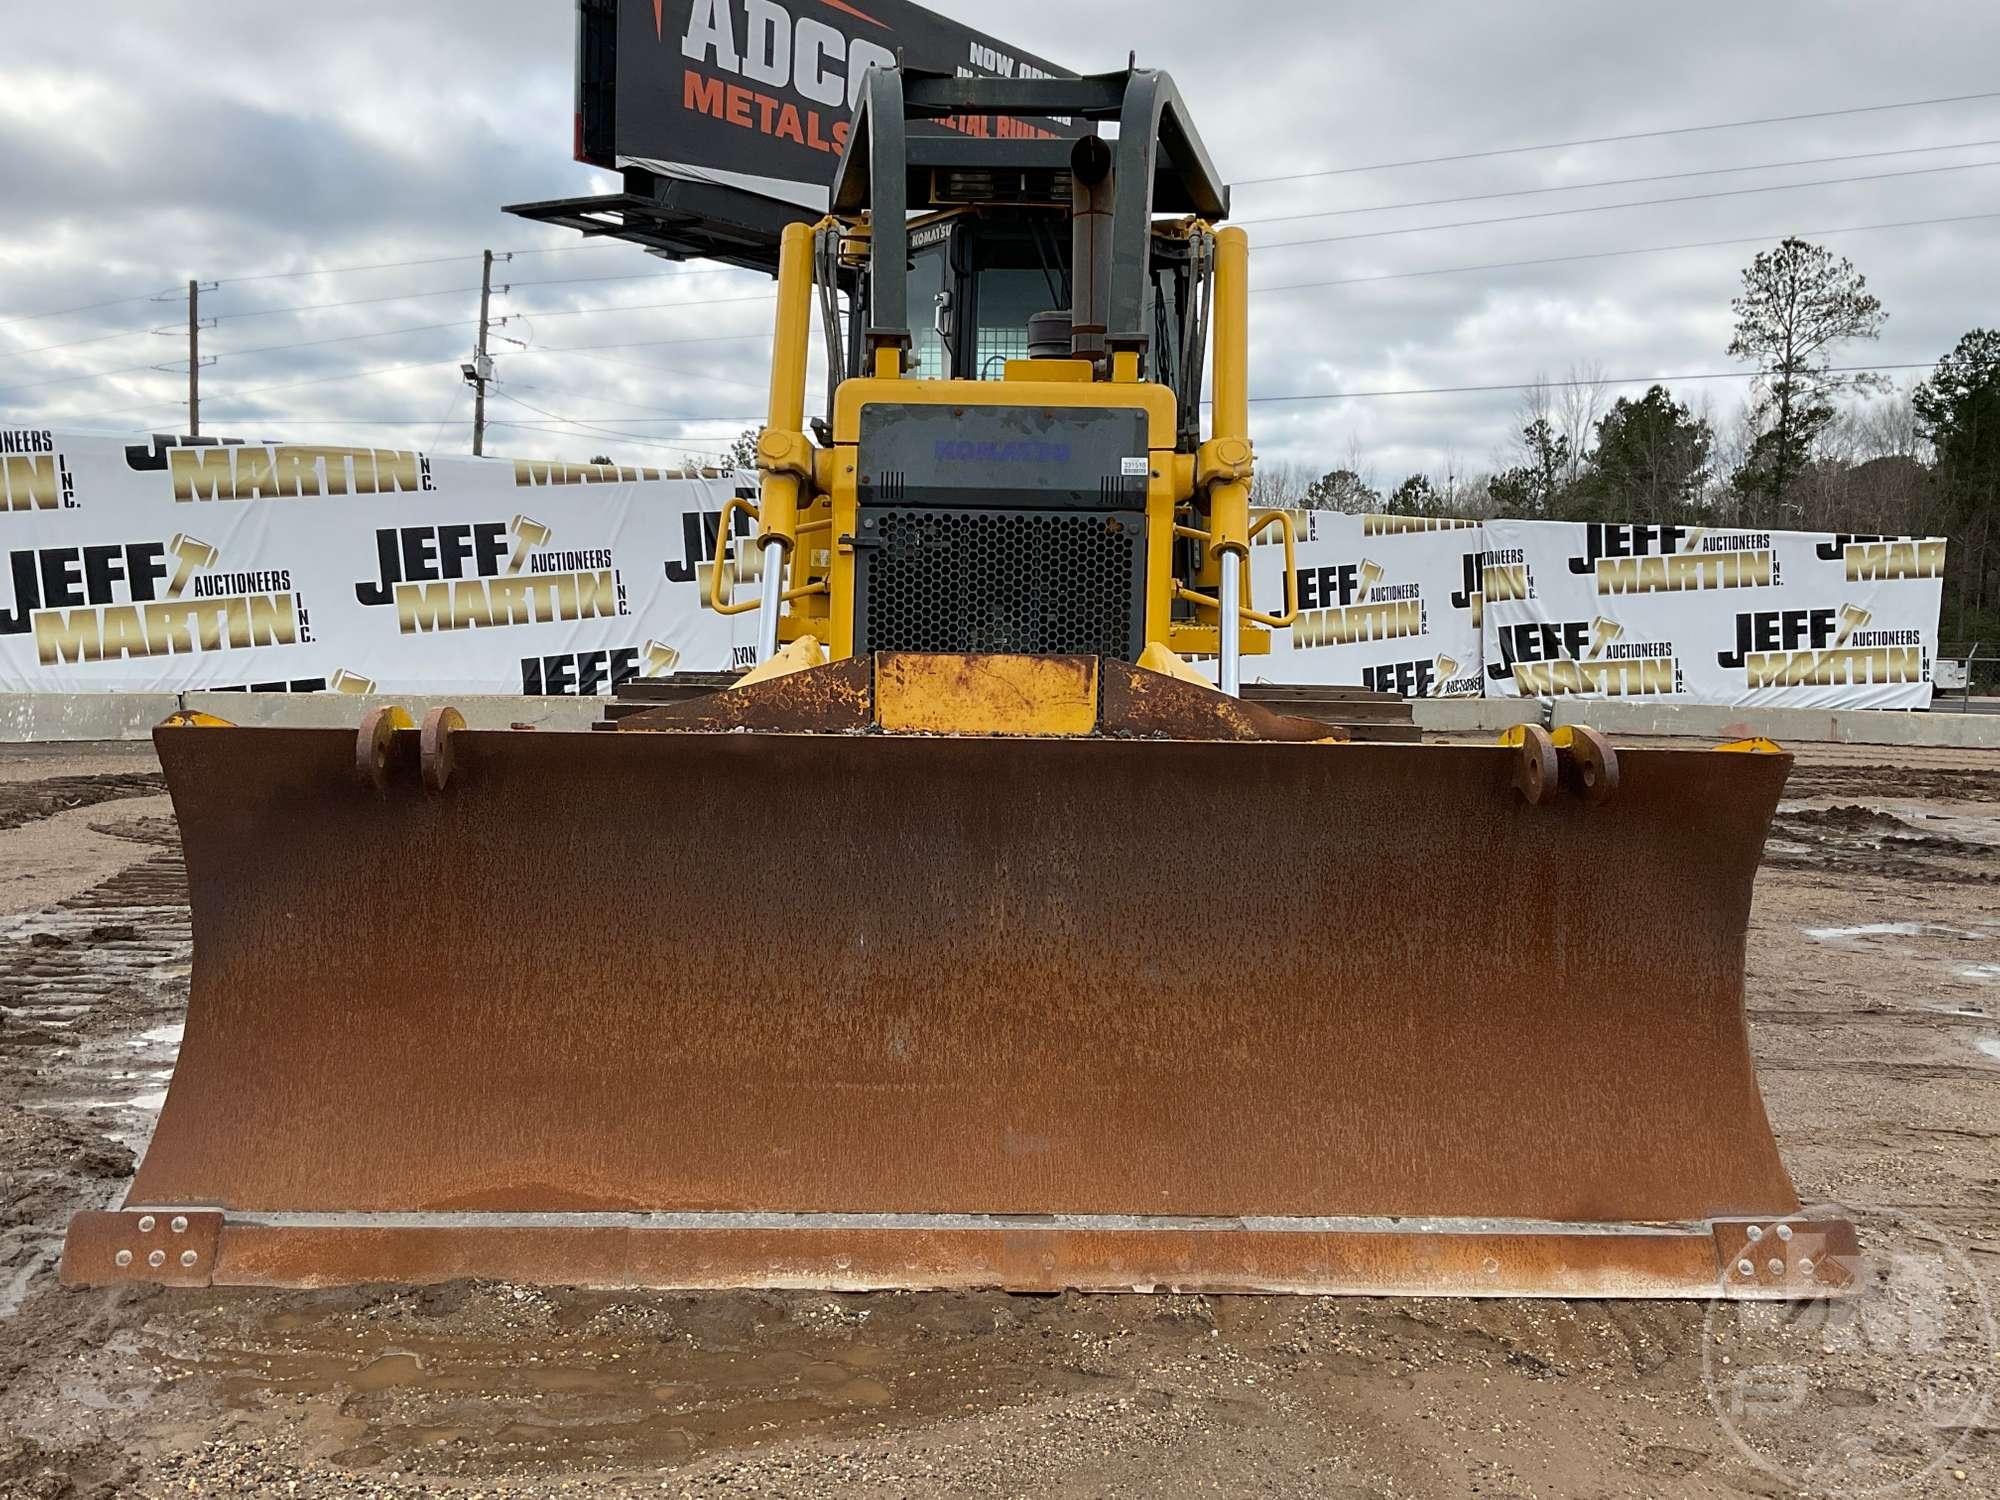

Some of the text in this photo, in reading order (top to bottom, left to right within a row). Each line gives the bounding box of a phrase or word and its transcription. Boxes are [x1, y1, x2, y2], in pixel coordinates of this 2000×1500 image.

[970, 41, 1014, 78] NOW
[684, 70, 850, 157] METALS
[912, 223, 952, 247] KOMATSU
[171, 446, 418, 502] MARTIN
[355, 522, 509, 607] JEFF
[530, 549, 612, 573] AUCTIONEERS
[1569, 524, 1685, 575] JEFF
[1703, 534, 1770, 553] AUCTIONEERS
[0, 543, 168, 635] JEFF
[194, 570, 291, 597] AUCTIONEERS
[1371, 584, 1419, 602] AUCTIONEERS
[1597, 552, 1769, 595] MARTIN
[396, 570, 617, 634] MARTIN
[34, 593, 296, 666] MARTIN
[1293, 600, 1419, 650] MARTIN
[1718, 609, 1836, 668] JEFF
[1852, 630, 1920, 647] AUCTIONEERS
[1487, 622, 1590, 680] JEFF
[1607, 642, 1672, 659] AUCTIONEERS
[1747, 647, 1919, 689] MARTIN
[1513, 659, 1672, 698] MARTIN
